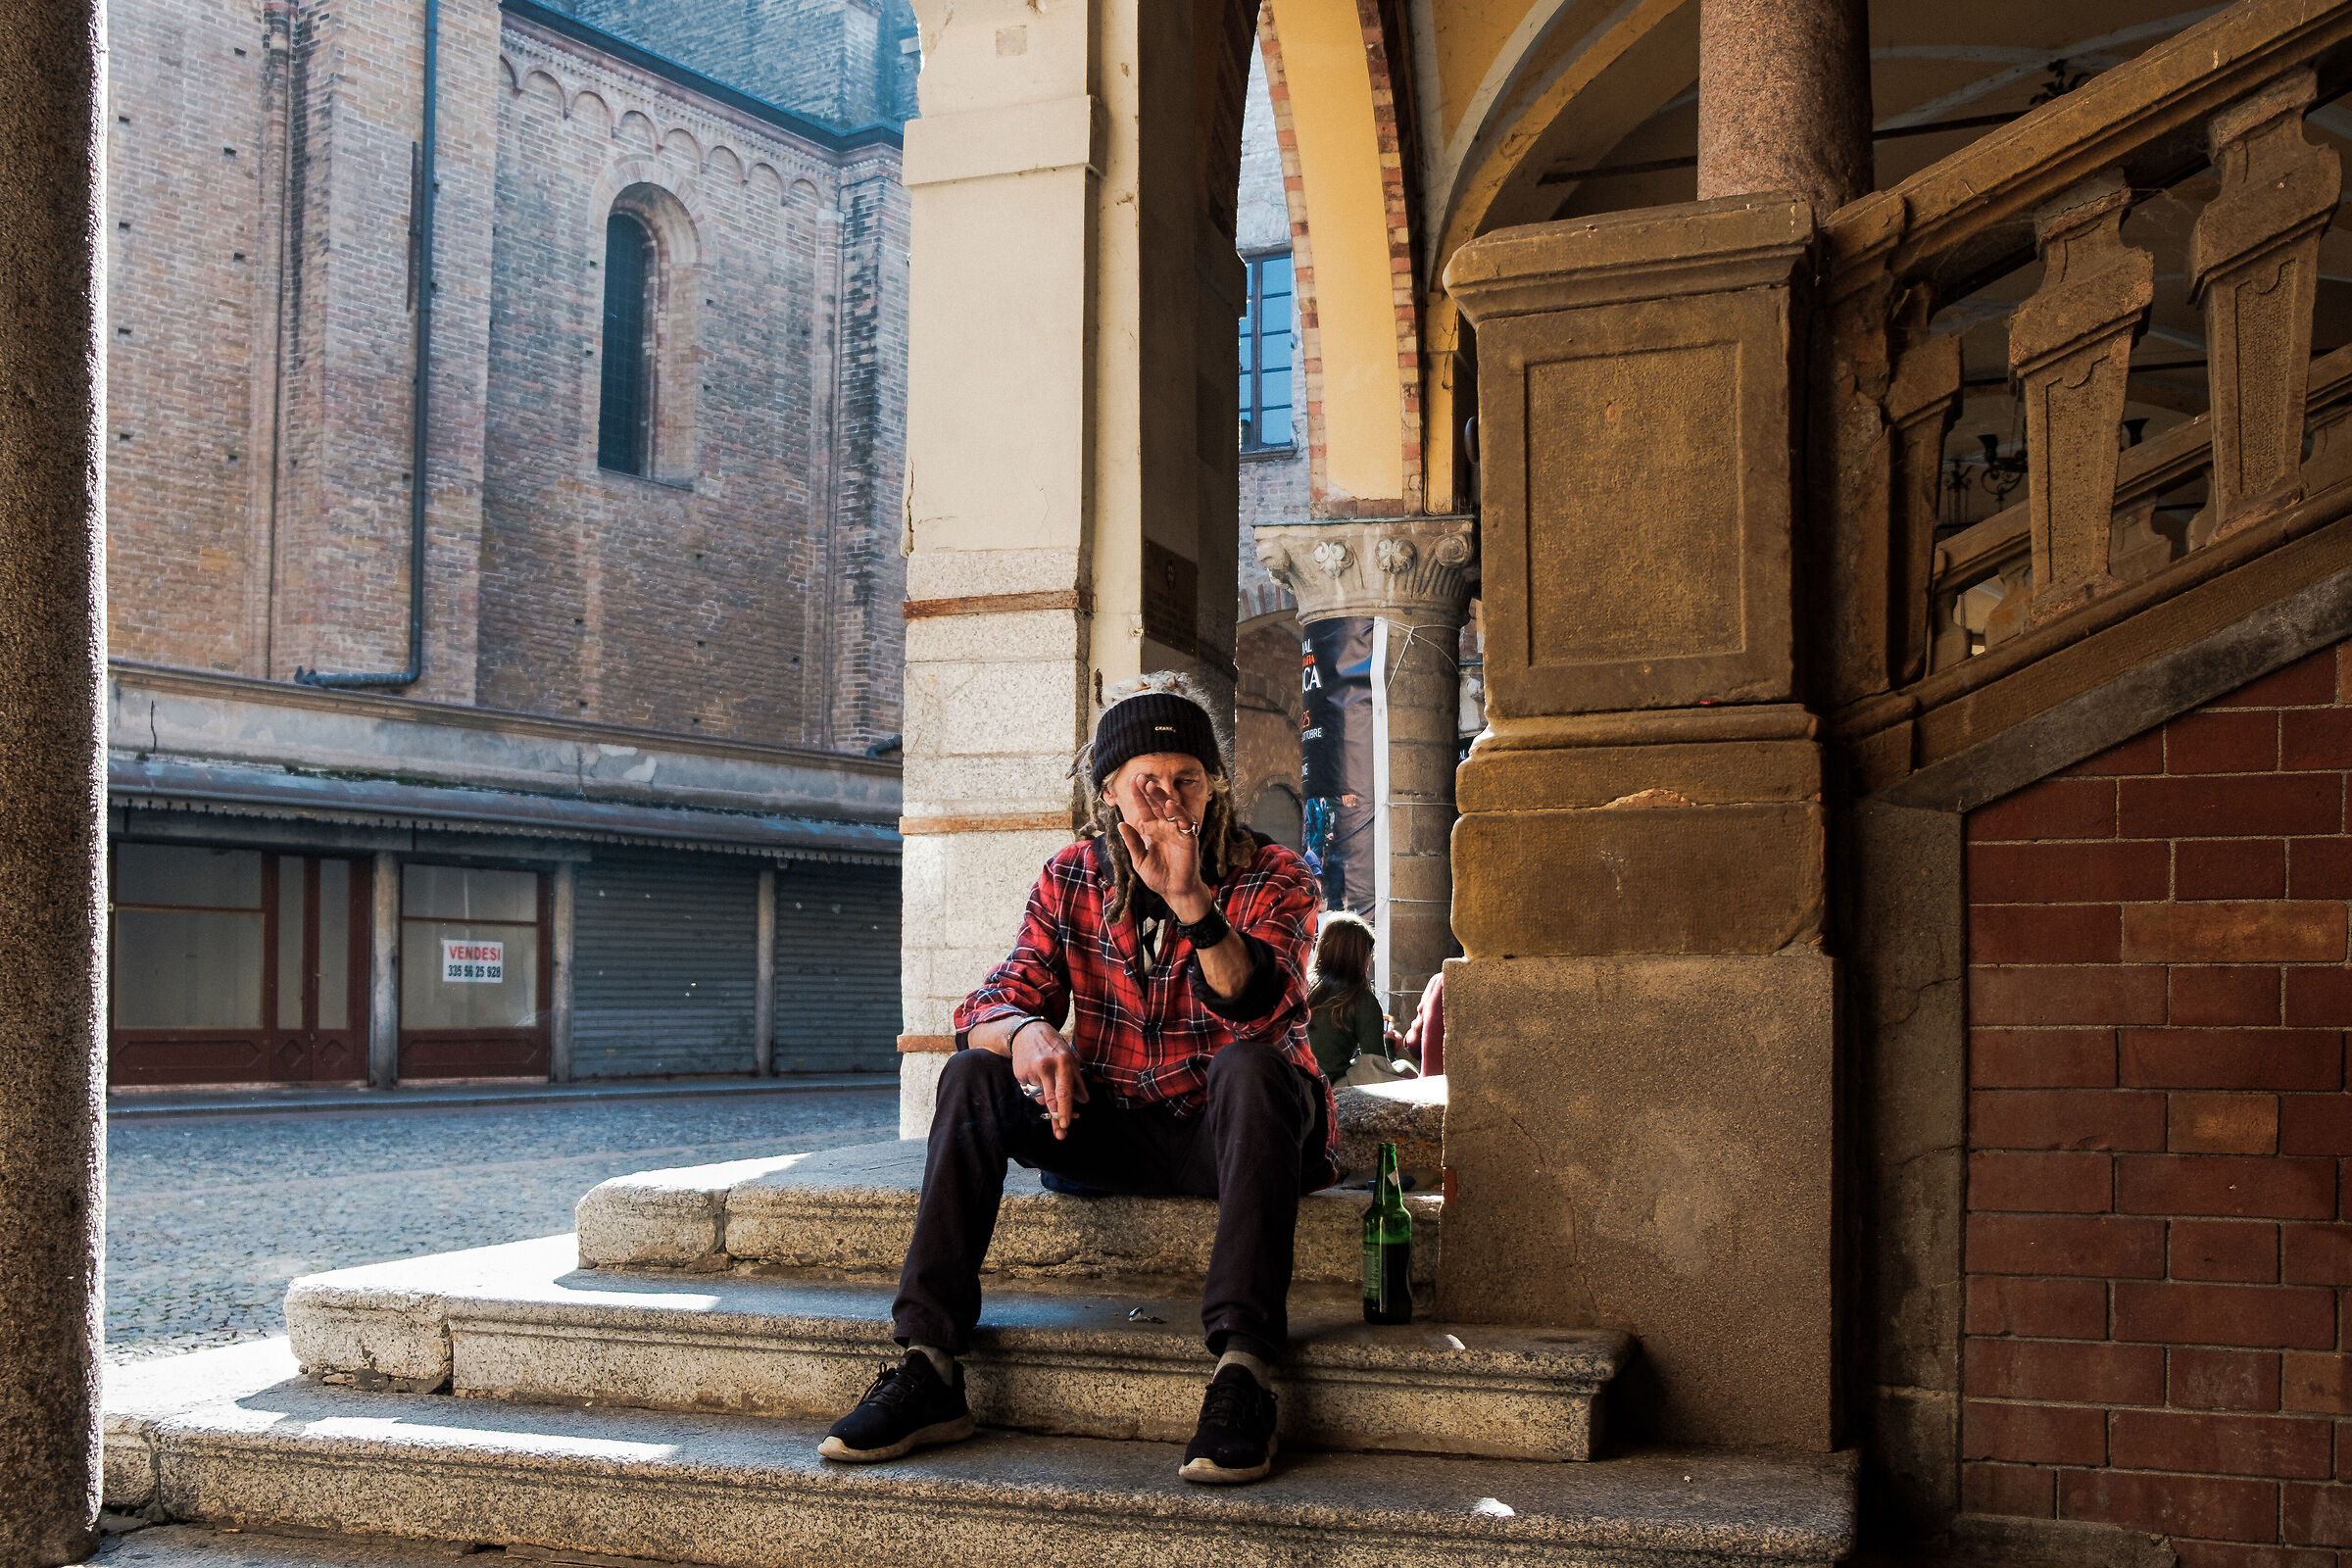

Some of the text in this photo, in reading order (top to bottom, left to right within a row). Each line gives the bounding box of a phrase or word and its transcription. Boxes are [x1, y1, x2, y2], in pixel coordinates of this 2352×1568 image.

[449, 946, 501, 961] VENDESI
[448, 964, 462, 977] 335
[475, 966, 485, 978] 25
